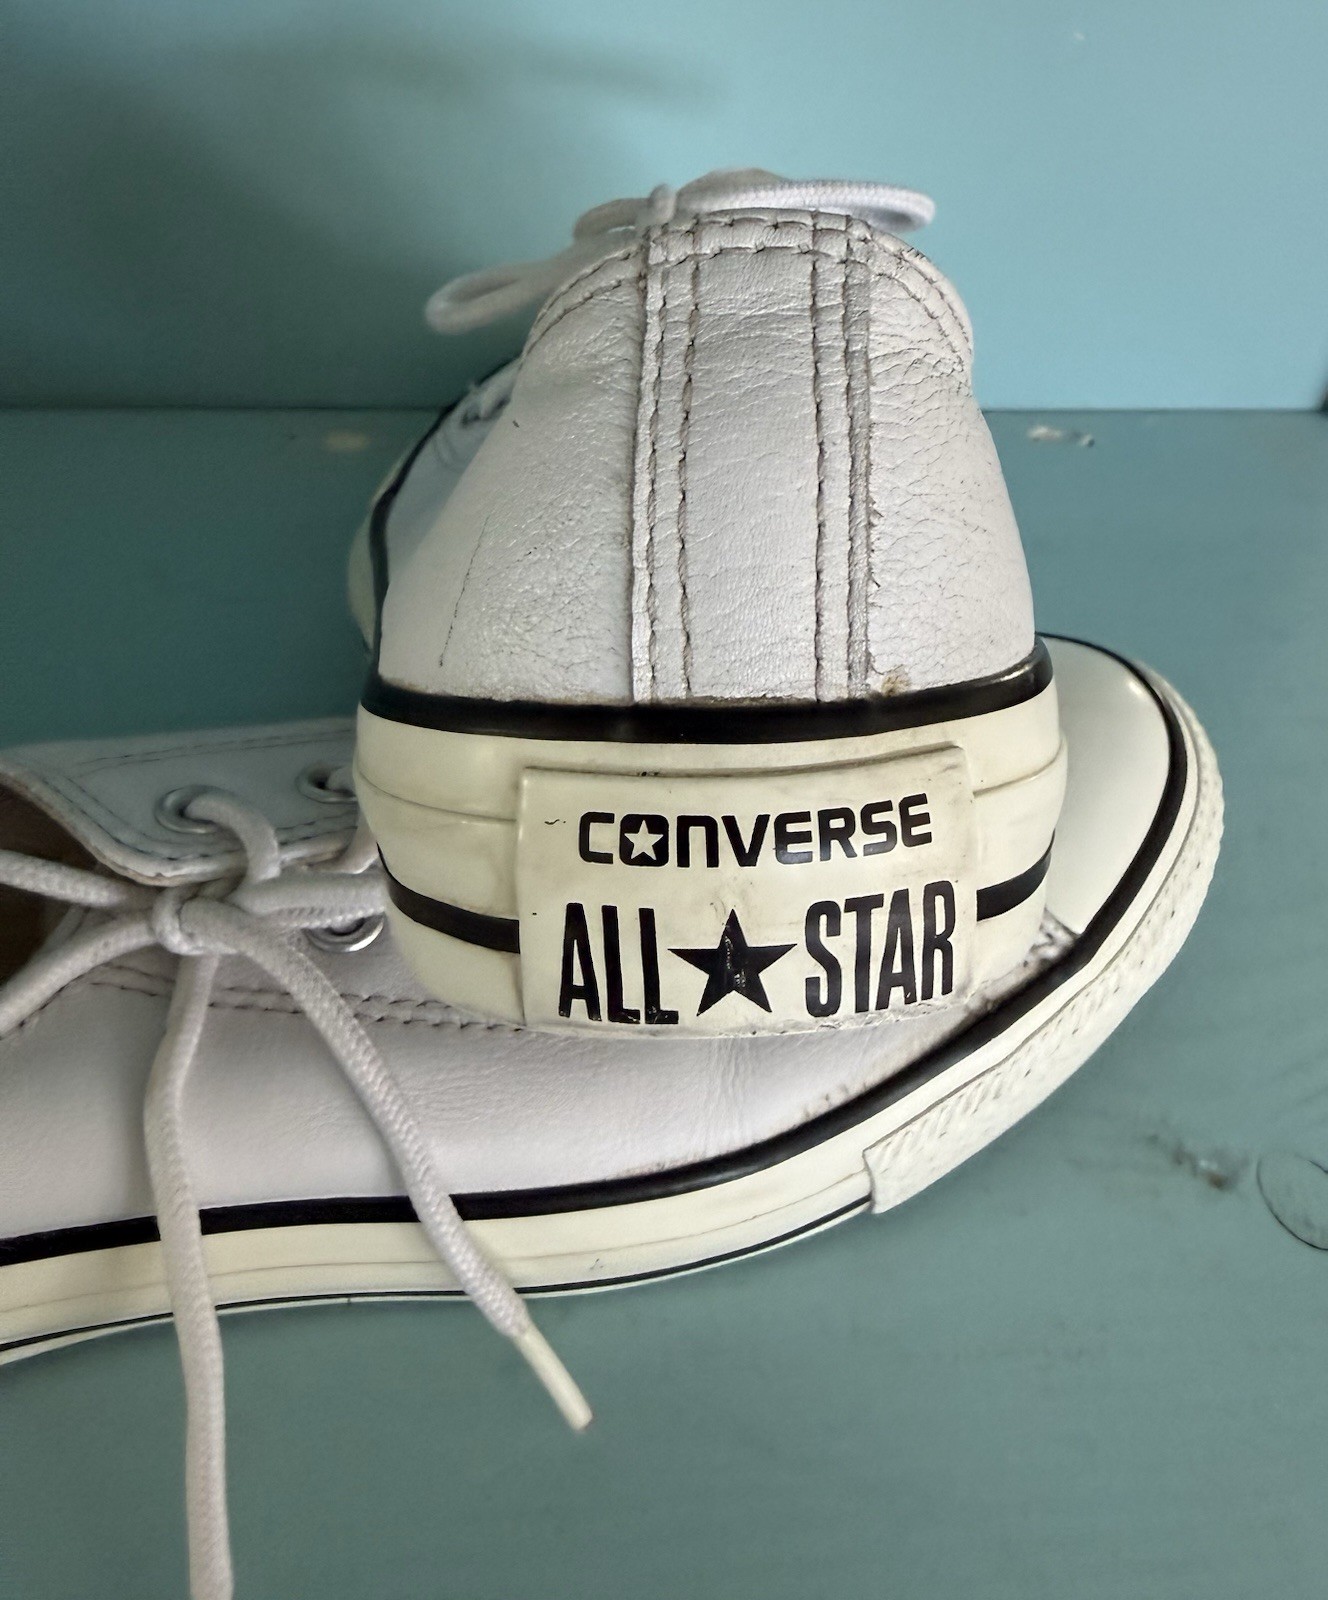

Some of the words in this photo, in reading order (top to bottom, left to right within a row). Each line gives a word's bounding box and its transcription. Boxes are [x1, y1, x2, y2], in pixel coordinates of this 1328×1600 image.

[578, 792, 933, 868] CONVERSE
[558, 902, 679, 1025] ALL
[804, 880, 956, 1018] STAR
